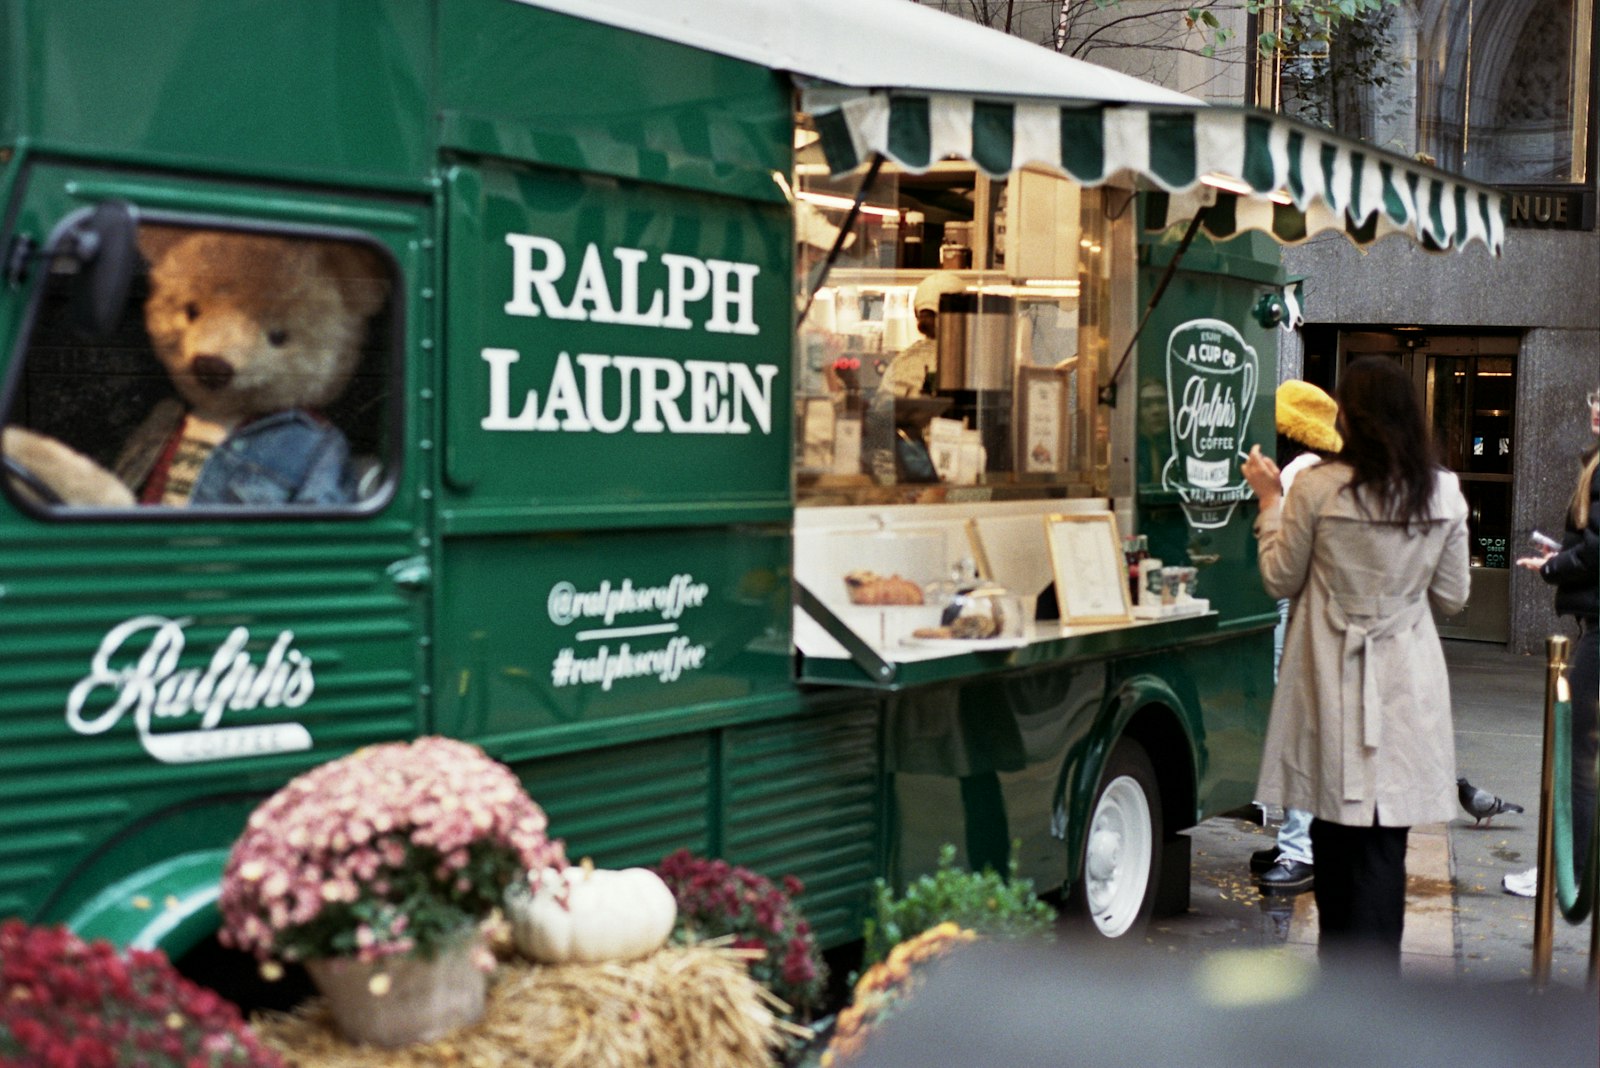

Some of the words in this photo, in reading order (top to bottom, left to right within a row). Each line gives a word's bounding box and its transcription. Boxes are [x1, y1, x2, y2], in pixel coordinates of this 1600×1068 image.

[504, 232, 760, 336] RALPH
[1186, 343, 1197, 364] A
[1198, 343, 1222, 364] CUP
[1222, 348, 1237, 369] OF
[480, 347, 779, 435] LAUREN
[1199, 436, 1235, 451] COFFEE
